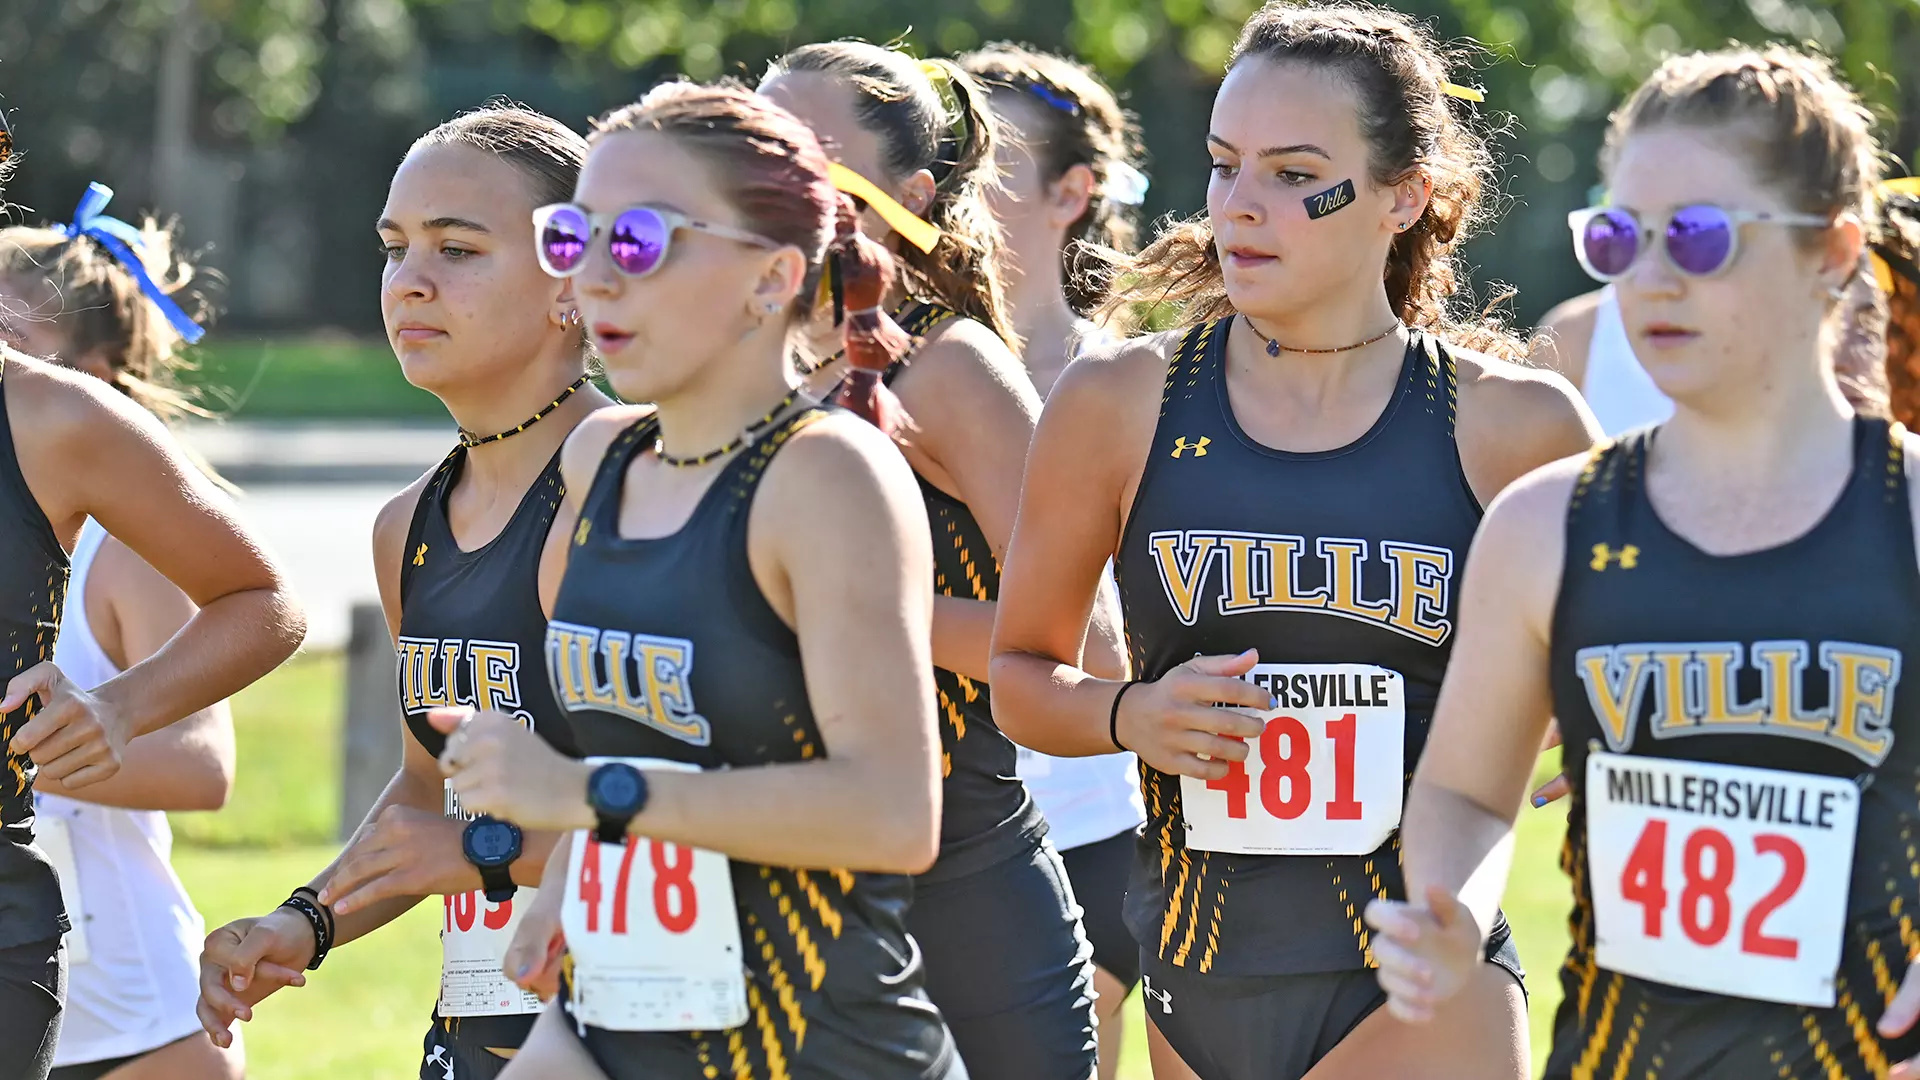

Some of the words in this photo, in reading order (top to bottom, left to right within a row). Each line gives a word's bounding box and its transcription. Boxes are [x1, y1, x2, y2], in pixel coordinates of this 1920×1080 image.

[1313, 185, 1348, 215] Ville
[1149, 530, 1453, 647] VILLE
[397, 636, 535, 735] ILLE
[545, 620, 711, 747] ILLE
[1576, 640, 1901, 768] VILLE
[1607, 767, 1836, 829] MILLERSVILLE
[579, 832, 698, 935] 478
[1619, 817, 1807, 961] 482
